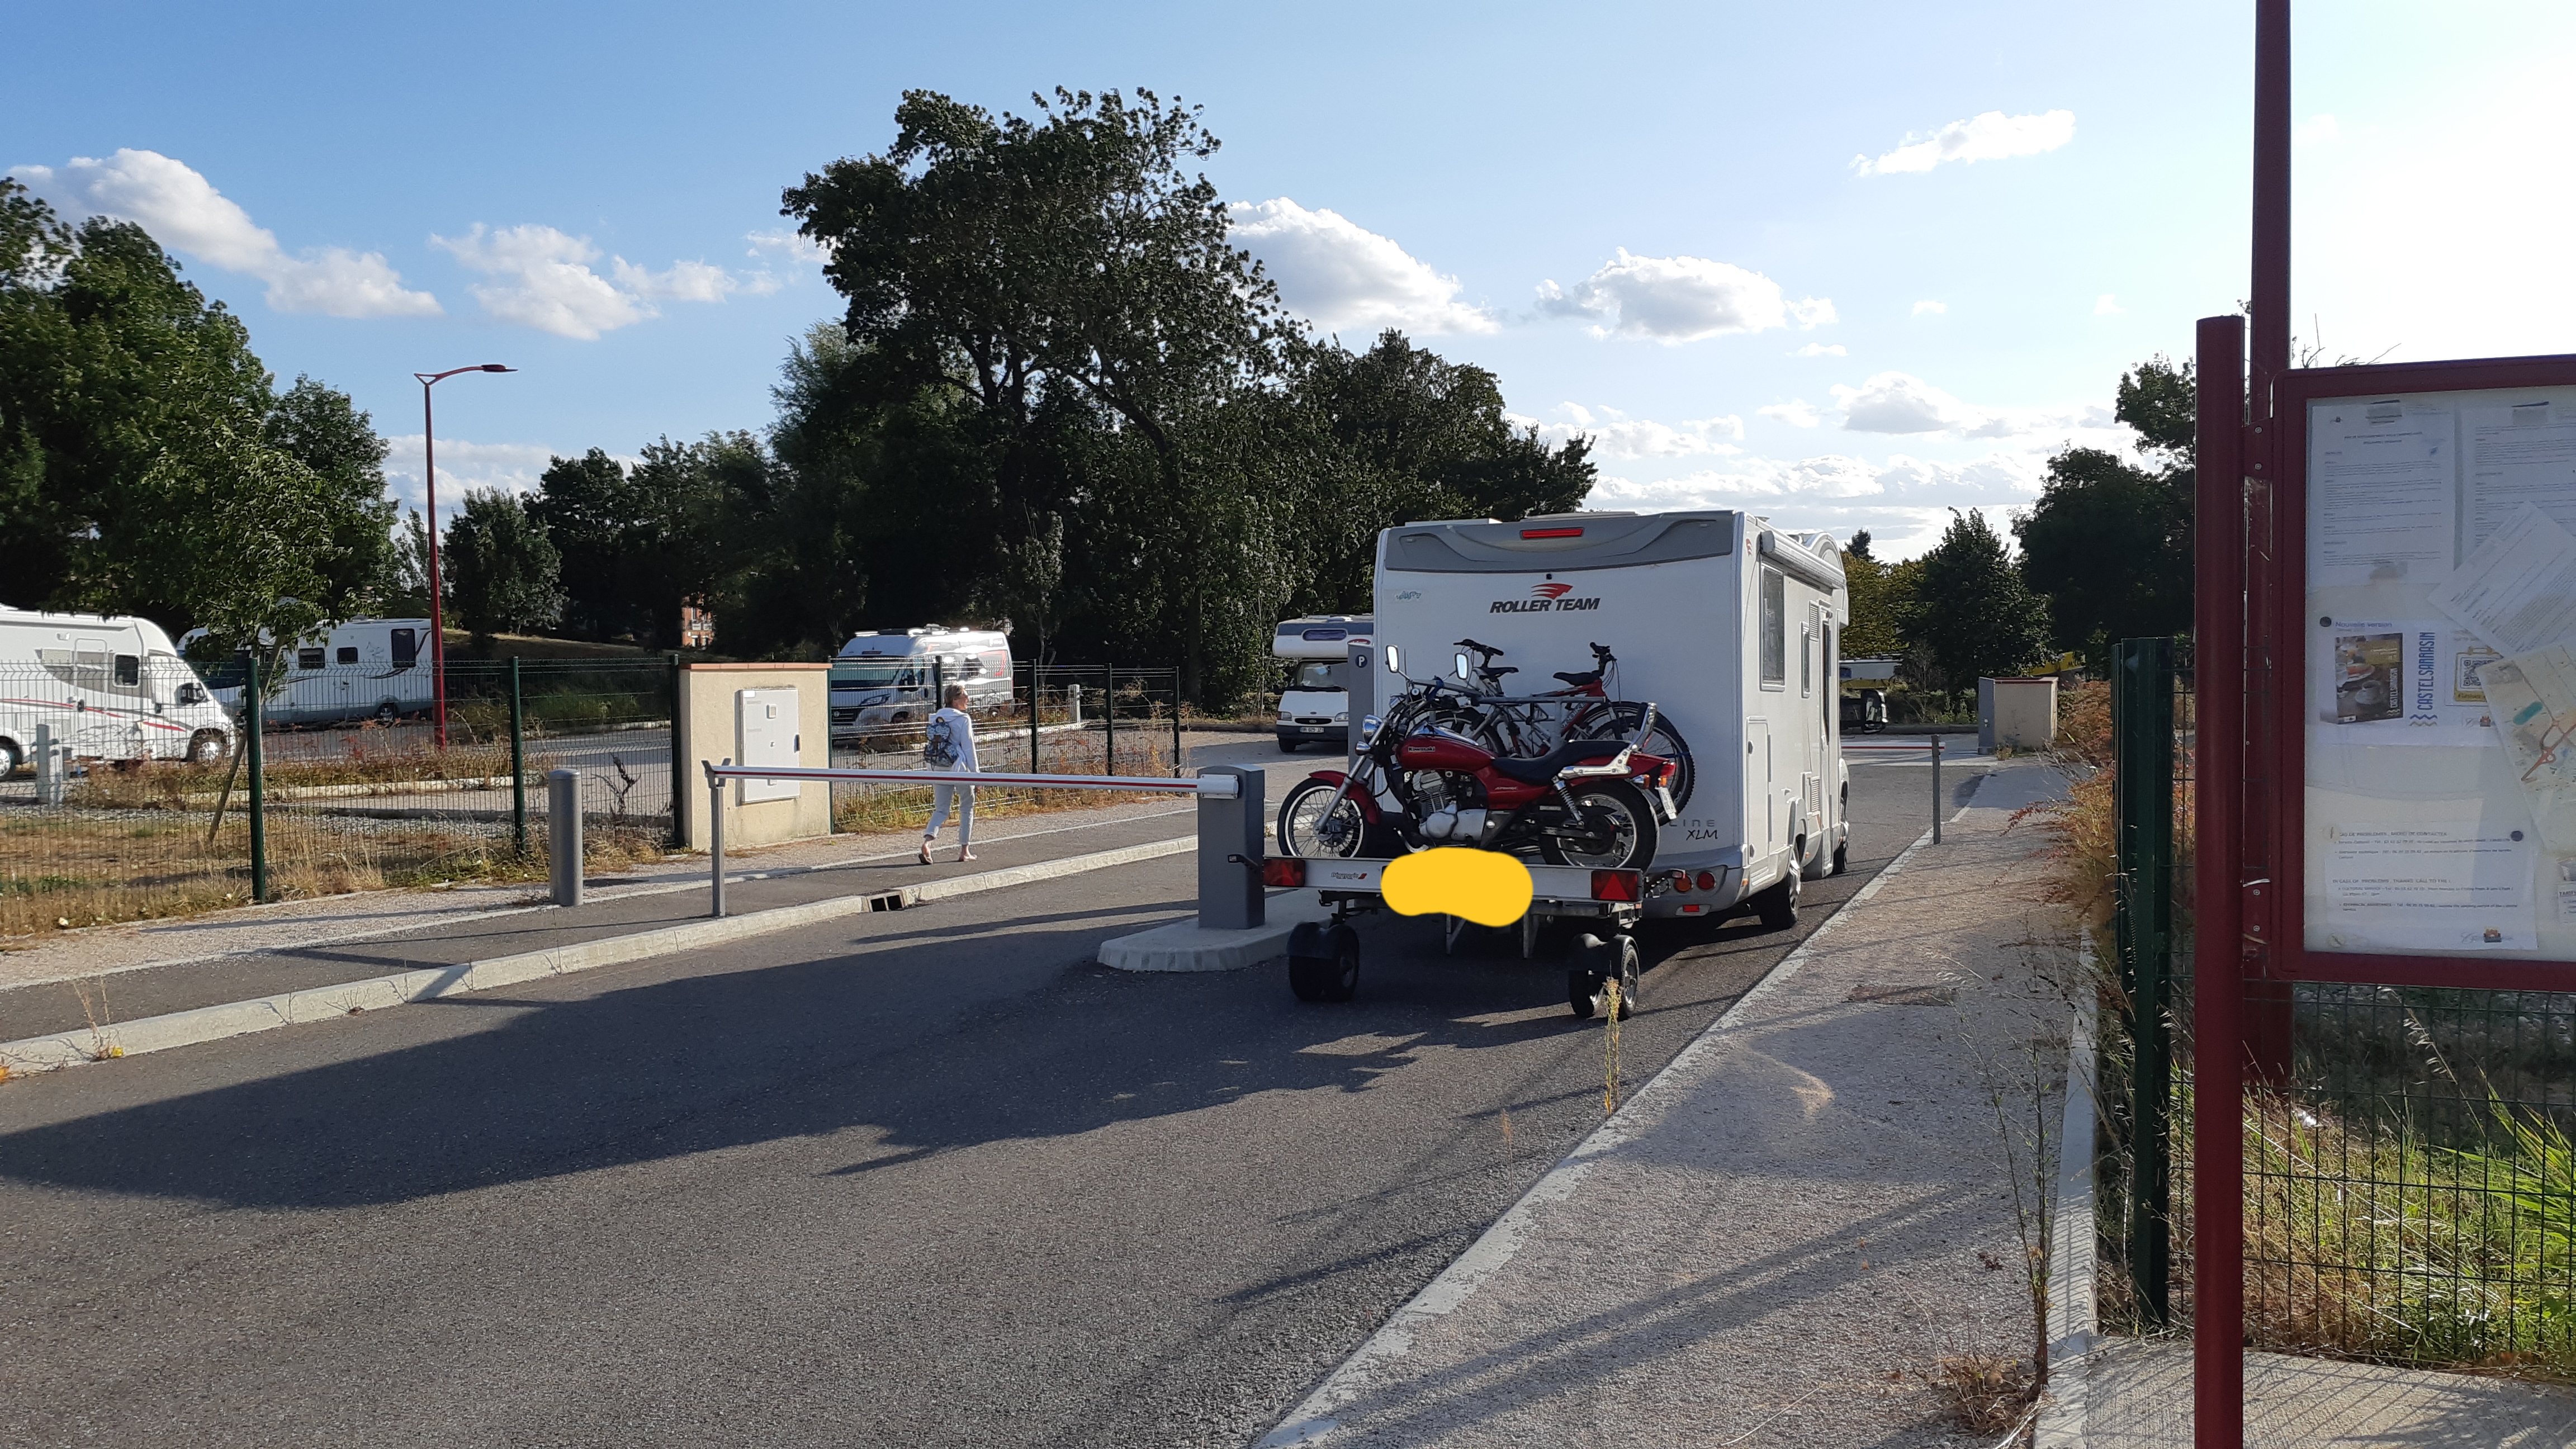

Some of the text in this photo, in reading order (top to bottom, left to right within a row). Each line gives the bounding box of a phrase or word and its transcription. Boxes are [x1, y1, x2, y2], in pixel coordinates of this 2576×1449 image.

[1489, 598, 1600, 613] ROLLER TEAM
[2417, 632, 2436, 711] CASTELSARRASIN
[1686, 829, 1718, 841] XLM
